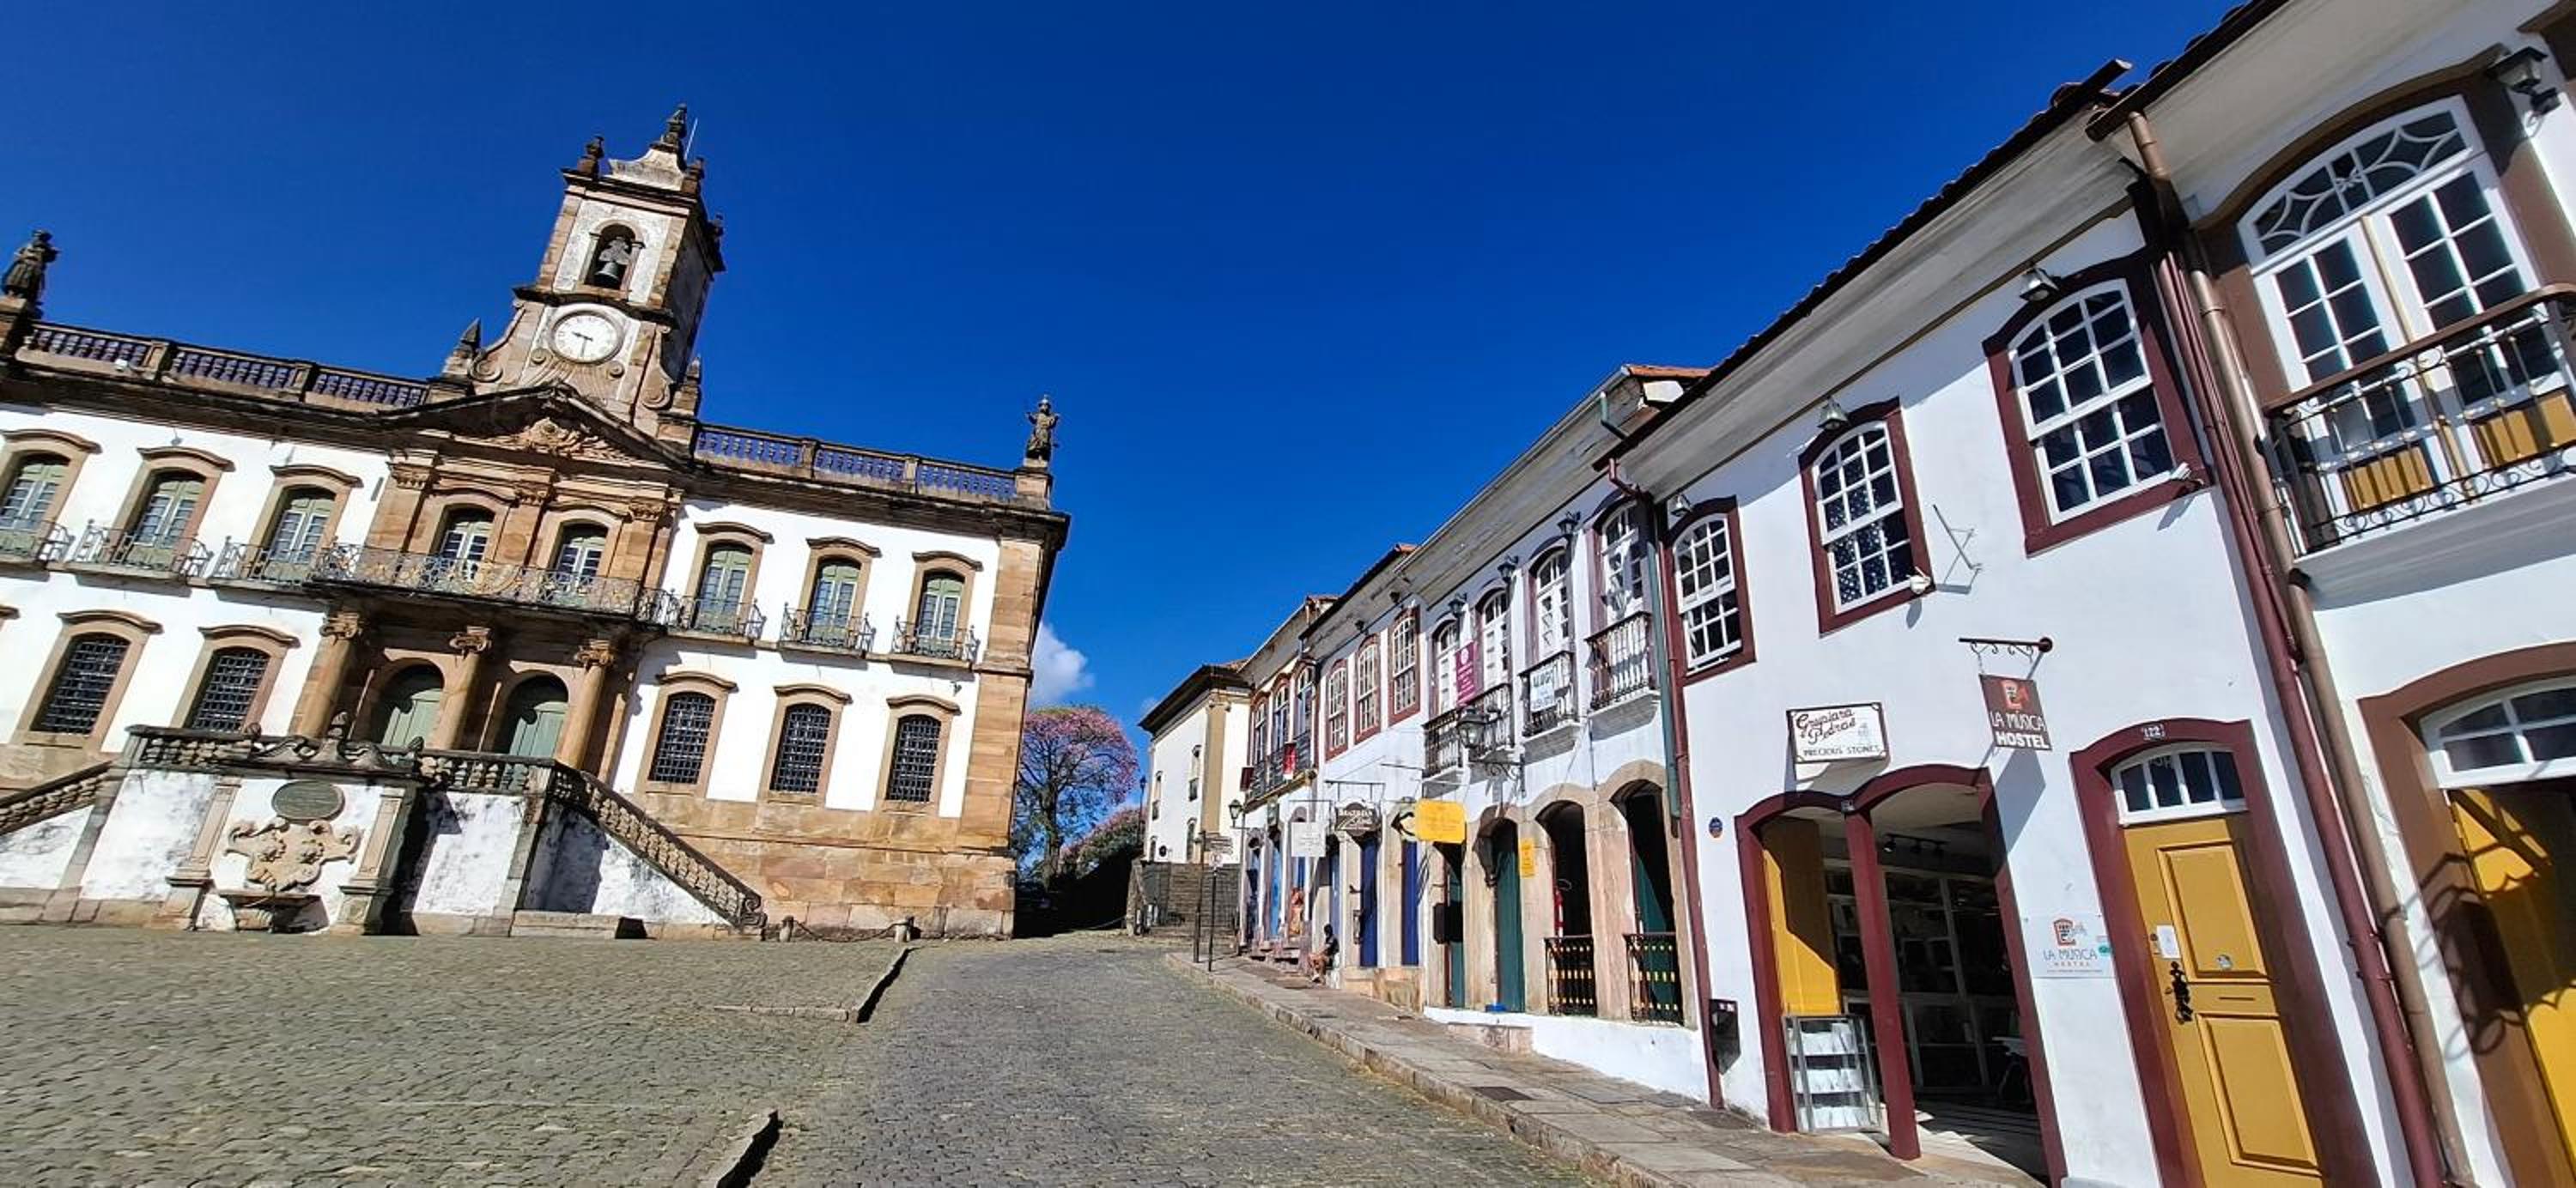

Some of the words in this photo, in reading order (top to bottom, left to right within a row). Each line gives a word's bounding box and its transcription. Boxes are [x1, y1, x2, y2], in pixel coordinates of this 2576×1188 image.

[1990, 711, 2005, 728] LA
[1808, 718, 1855, 744] Pedras
[1996, 731, 2050, 749] HOSTEL
[1803, 747, 1843, 756] PRECIOUS
[1846, 744, 1880, 755] STONES
[2043, 949, 2056, 961] LA
